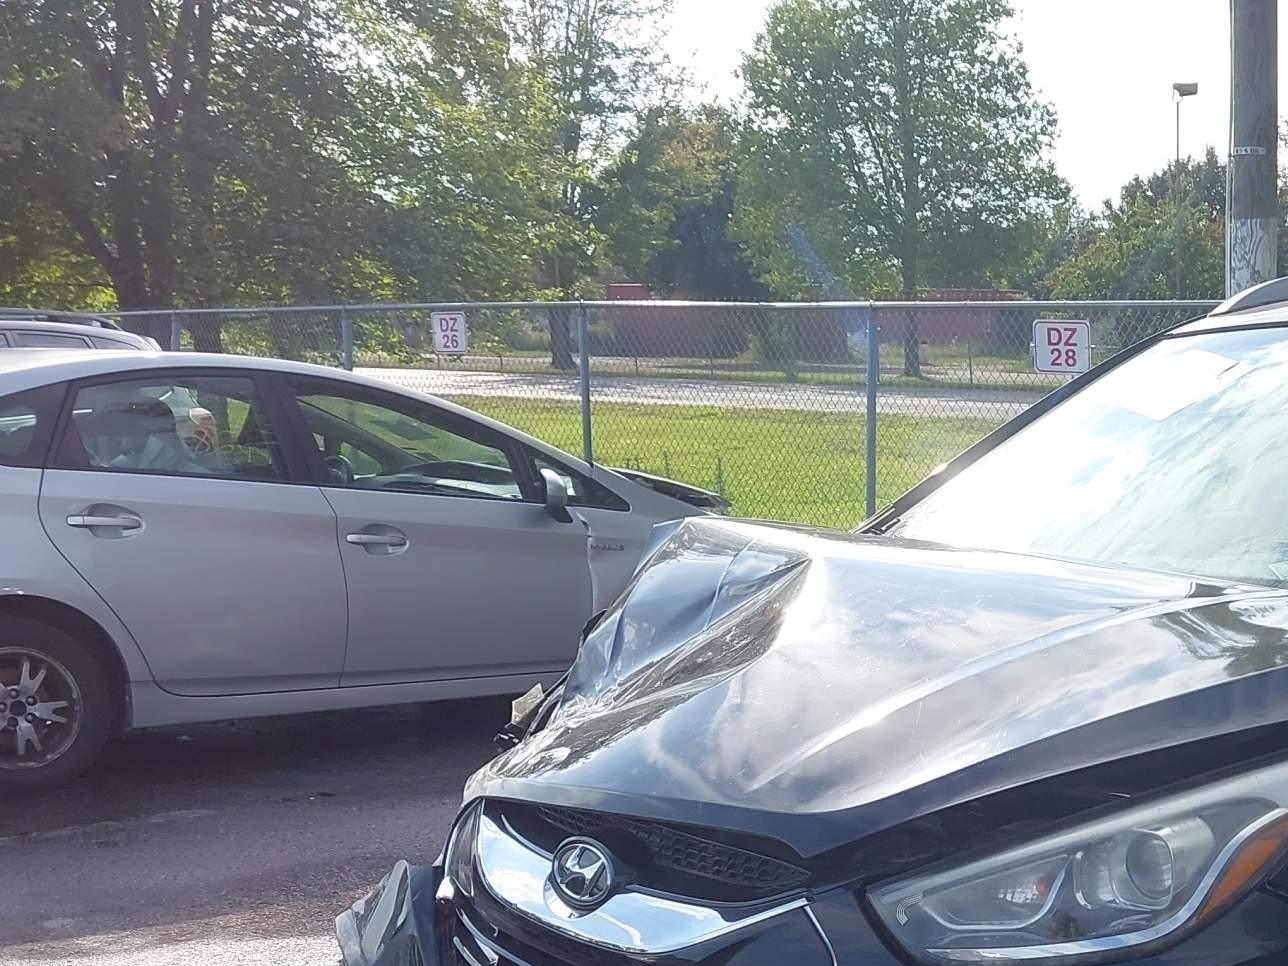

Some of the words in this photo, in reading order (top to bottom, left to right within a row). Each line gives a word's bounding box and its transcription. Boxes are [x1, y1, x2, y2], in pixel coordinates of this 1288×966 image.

[440, 318, 458, 332] DZ
[442, 335, 459, 348] 26
[1047, 327, 1077, 346] DZ
[1050, 348, 1077, 367] 28
